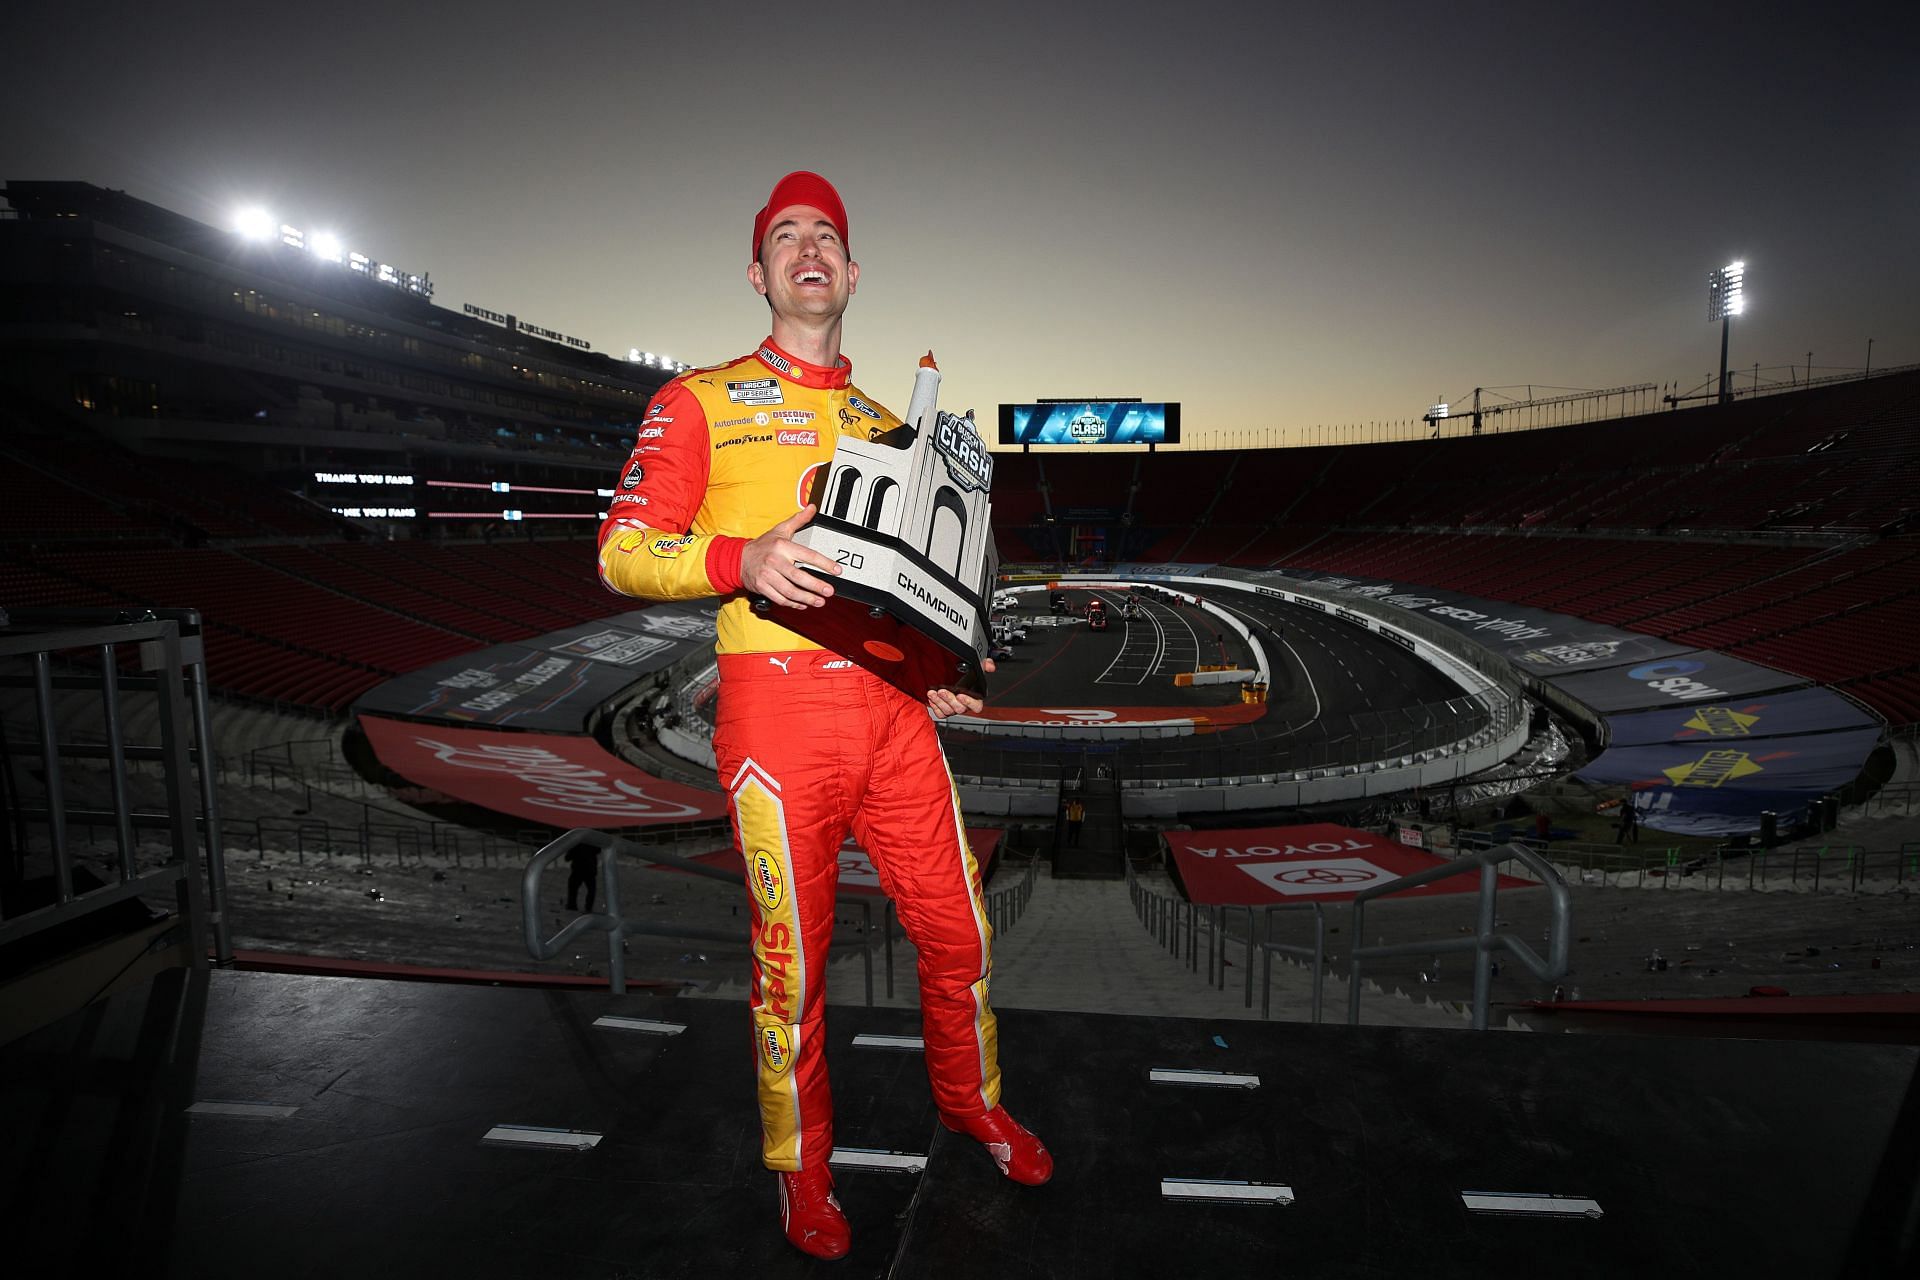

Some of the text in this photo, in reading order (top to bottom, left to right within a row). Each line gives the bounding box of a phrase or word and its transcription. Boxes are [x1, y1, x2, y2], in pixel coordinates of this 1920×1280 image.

[464, 304, 590, 349] UNITED AIRLINES FIELD
[743, 381, 771, 389] NASCAR
[772, 411, 815, 420] DISCOUNT
[855, 400, 876, 417] Ford
[714, 418, 753, 428] Autotrader
[1072, 424, 1105, 434] CLASH
[716, 435, 773, 449] GOODYEAR
[777, 431, 817, 445] Coca-Cola
[940, 423, 990, 482] CLASH
[315, 473, 414, 485] THANK YOU FANS
[363, 508, 387, 517] YOU
[388, 508, 416, 517] FANS
[836, 549, 864, 570] 20
[897, 572, 969, 631] CHAMPION
[823, 660, 858, 669] JOEY
[1184, 839, 1373, 858] TOYOTA
[759, 857, 775, 901] PENNZOIL
